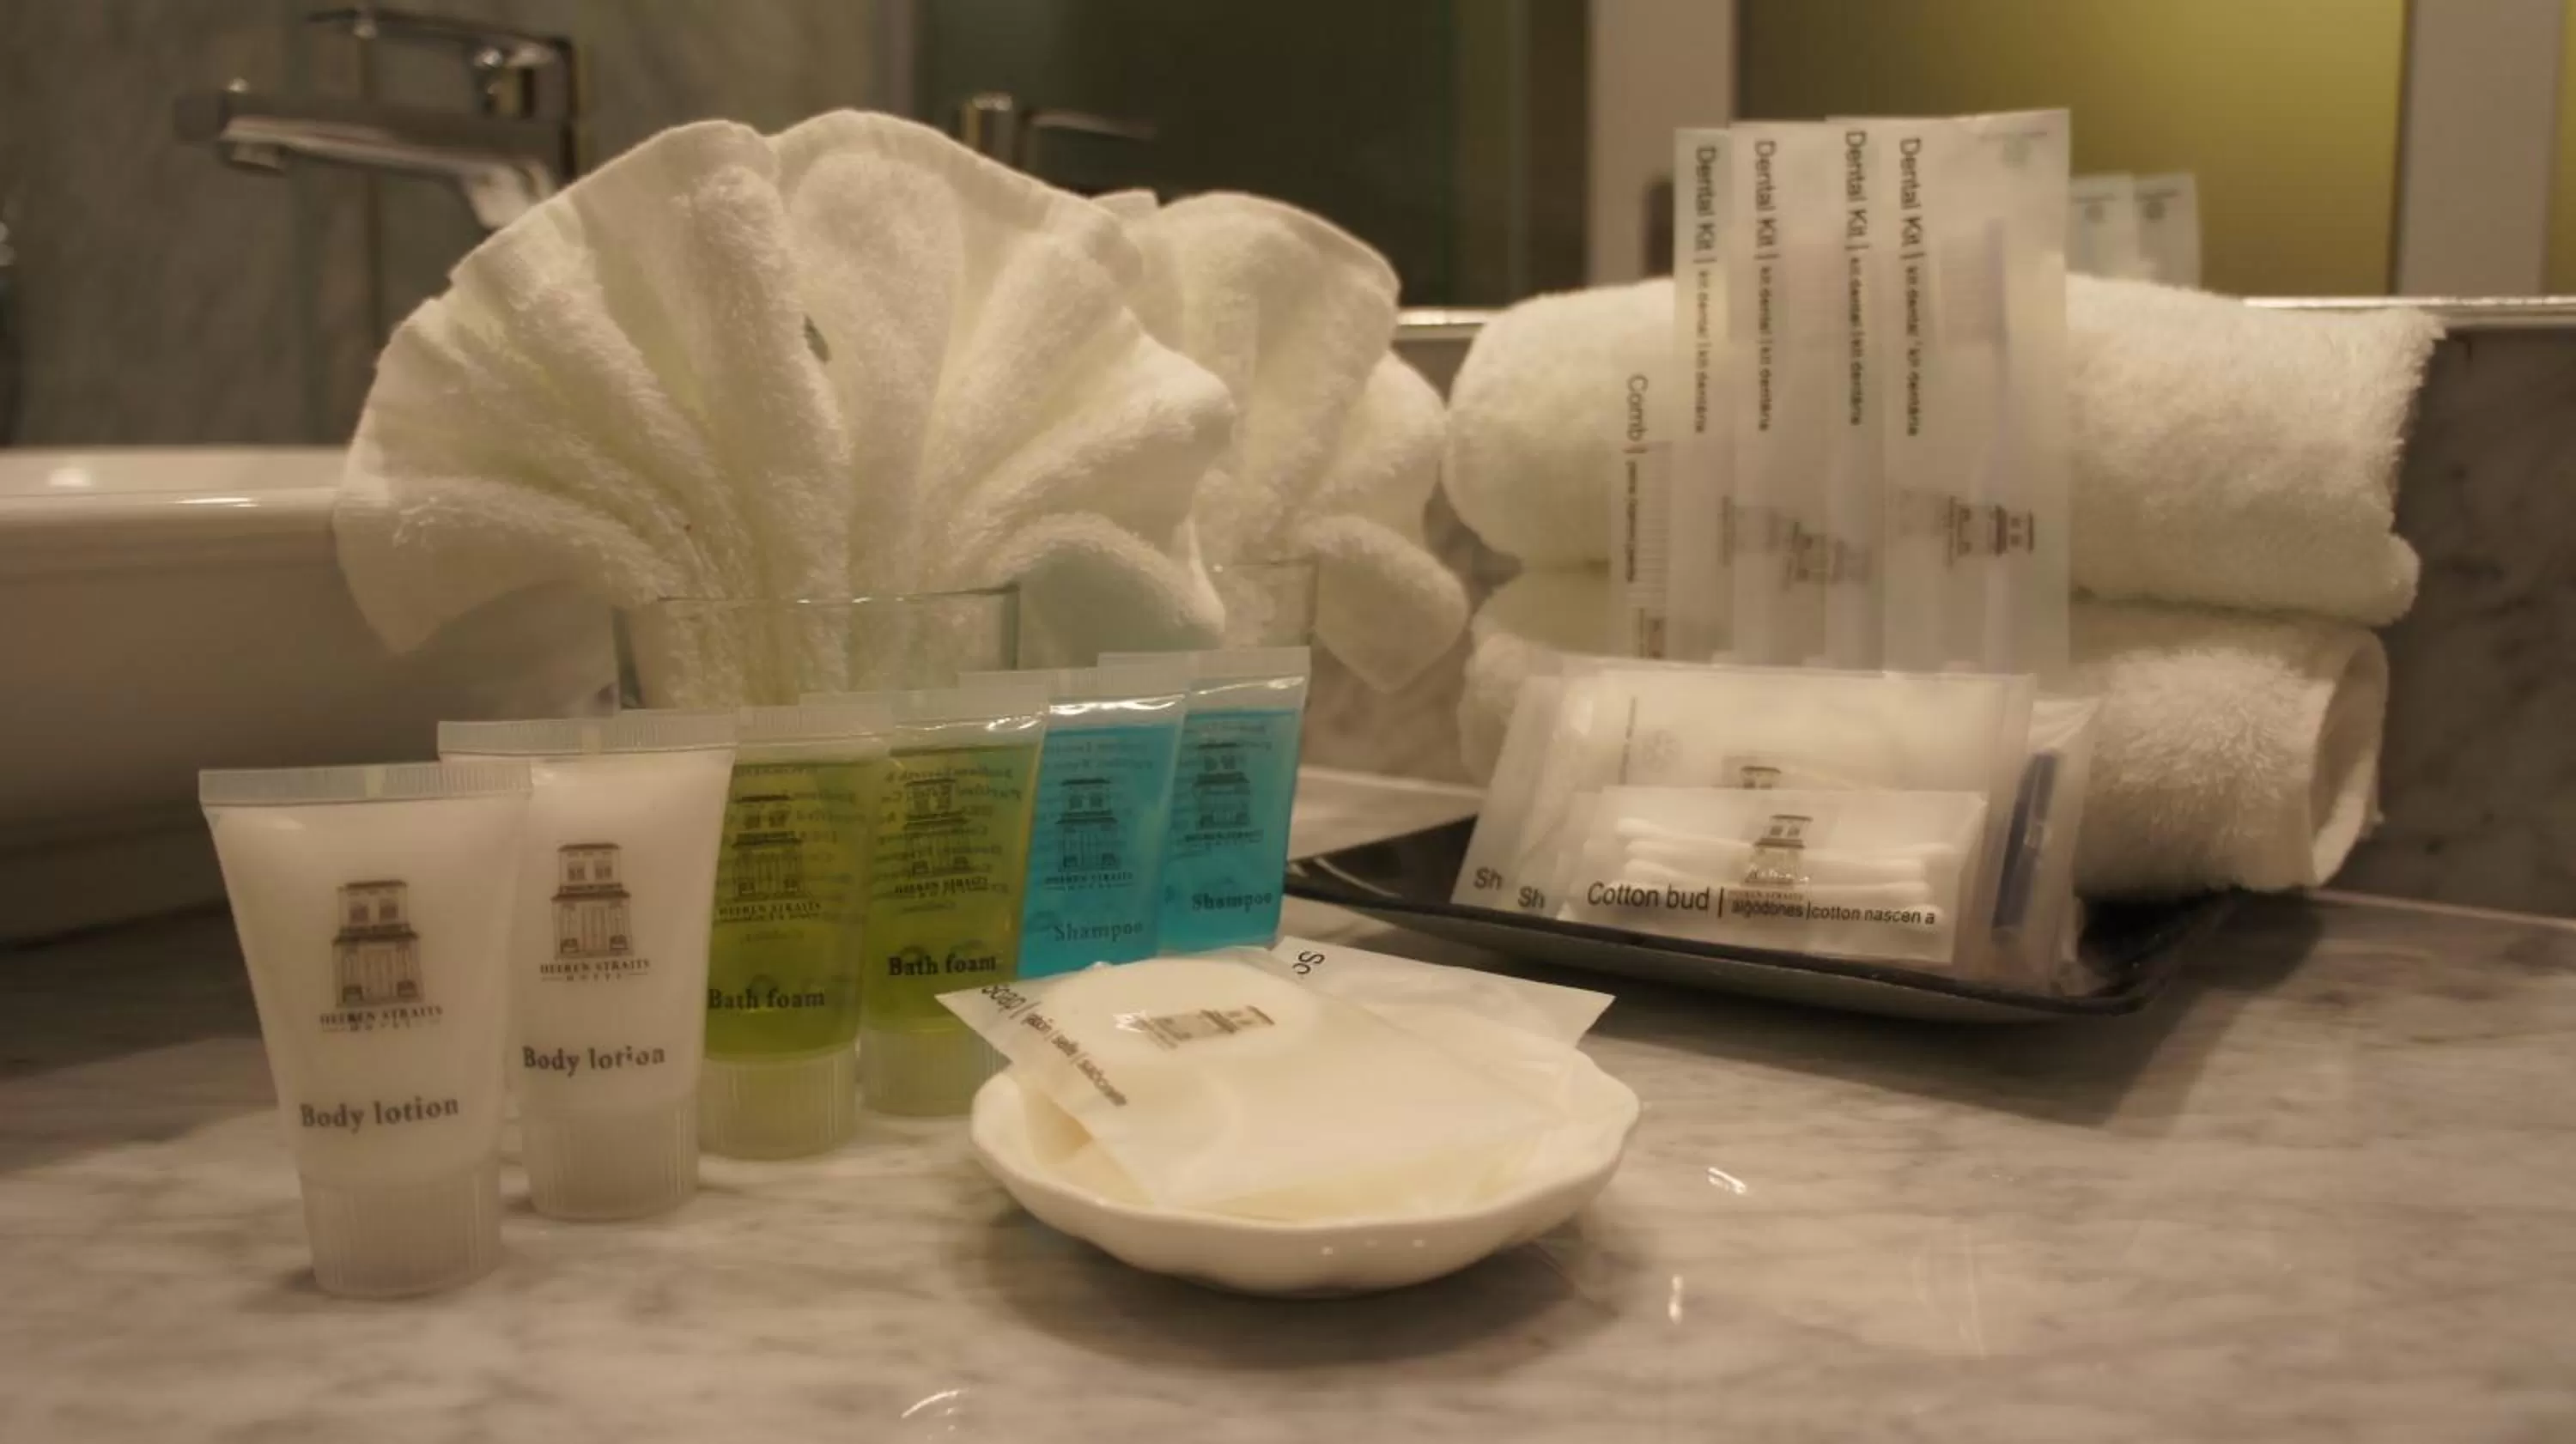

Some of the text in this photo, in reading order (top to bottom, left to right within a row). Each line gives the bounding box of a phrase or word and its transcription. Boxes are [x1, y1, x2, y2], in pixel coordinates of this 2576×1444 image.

[1695, 146, 1717, 215] Dental
[1754, 140, 1777, 212] Dental
[1844, 130, 1868, 203] Dental
[1899, 137, 1922, 209] Dental
[1694, 221, 1716, 251] Kit
[1755, 216, 1778, 250] Kit
[1846, 209, 1868, 239] Kit
[1901, 215, 1923, 246] Kit
[1625, 374, 1649, 443] Comb
[1190, 892, 1273, 914] Shampoo
[1588, 881, 1710, 911] Cotton bud
[1053, 921, 1145, 943] Shampoo
[887, 953, 997, 976] Bath foam
[708, 987, 825, 1010] Bath foam
[522, 1045, 665, 1078] Body lotion
[300, 1095, 459, 1135] Body lotion
